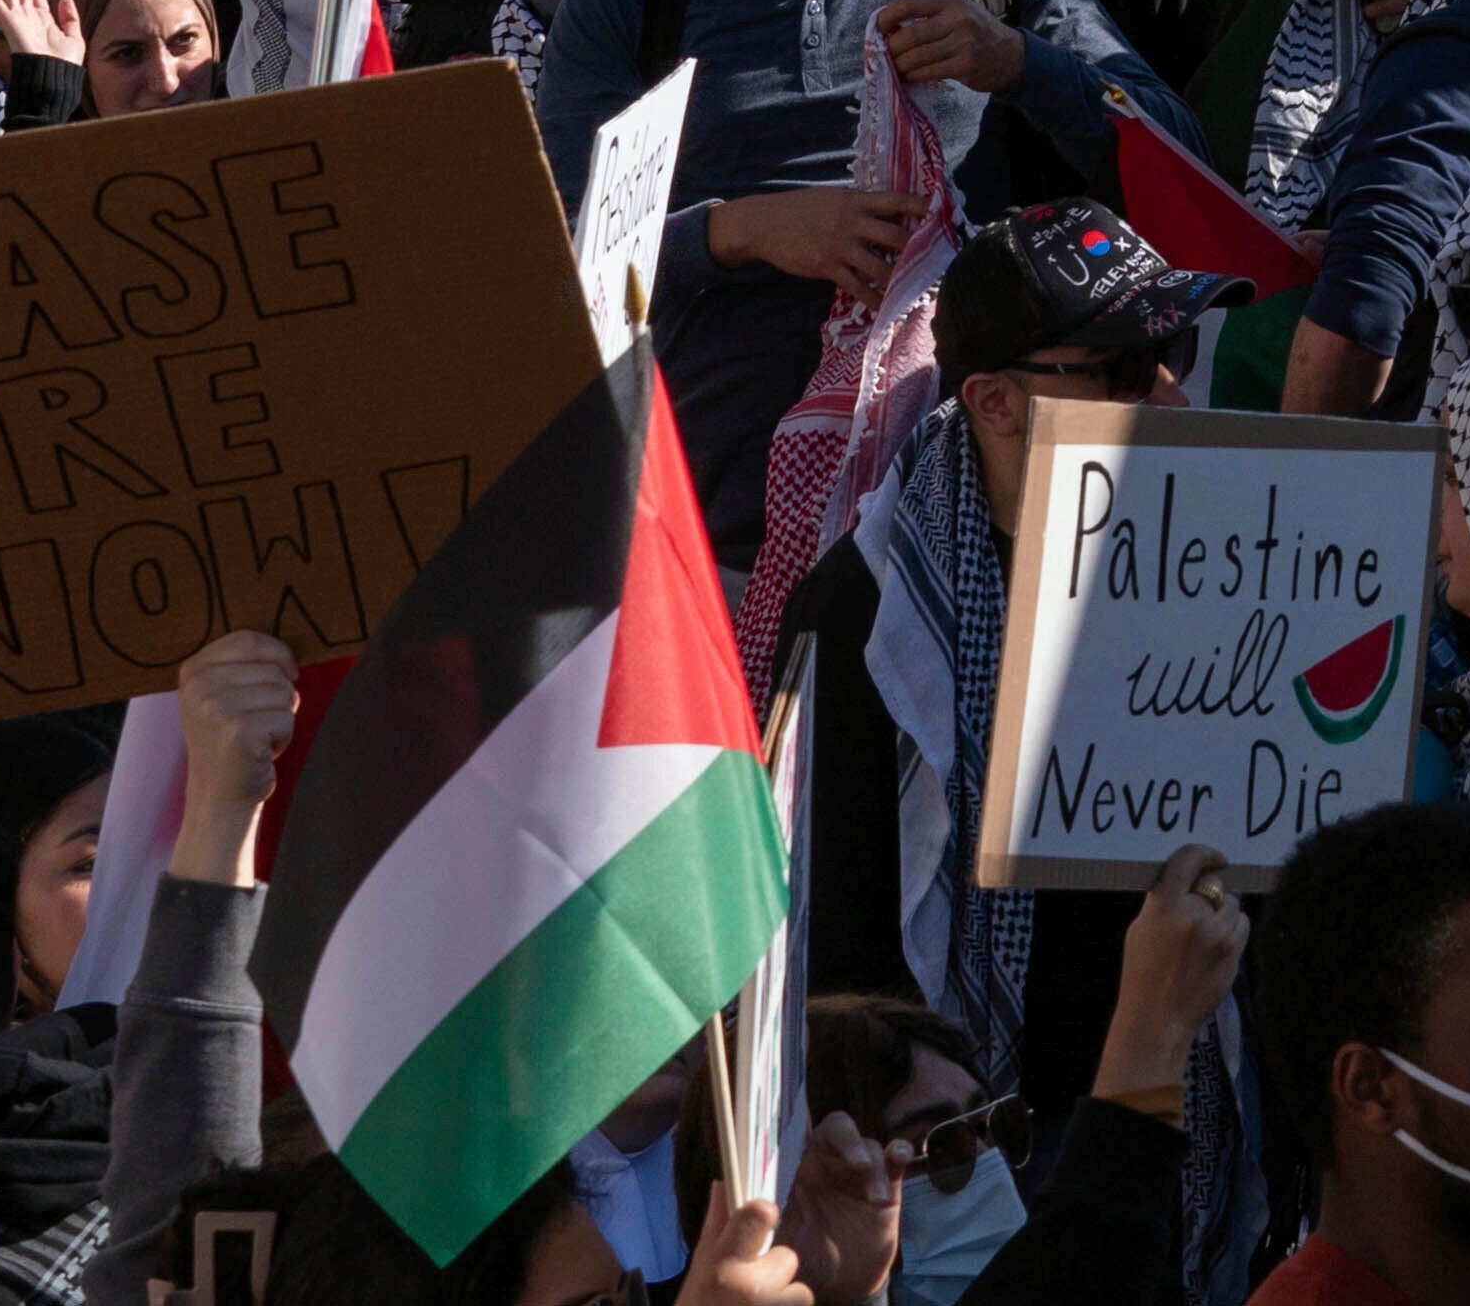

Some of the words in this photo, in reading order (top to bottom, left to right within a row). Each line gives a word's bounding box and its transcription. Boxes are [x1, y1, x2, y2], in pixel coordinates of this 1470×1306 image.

[1067, 460, 1386, 614] Palestine
[1125, 606, 1279, 722] will
[1033, 735, 1215, 840] Never
[1245, 730, 1345, 837] Die
